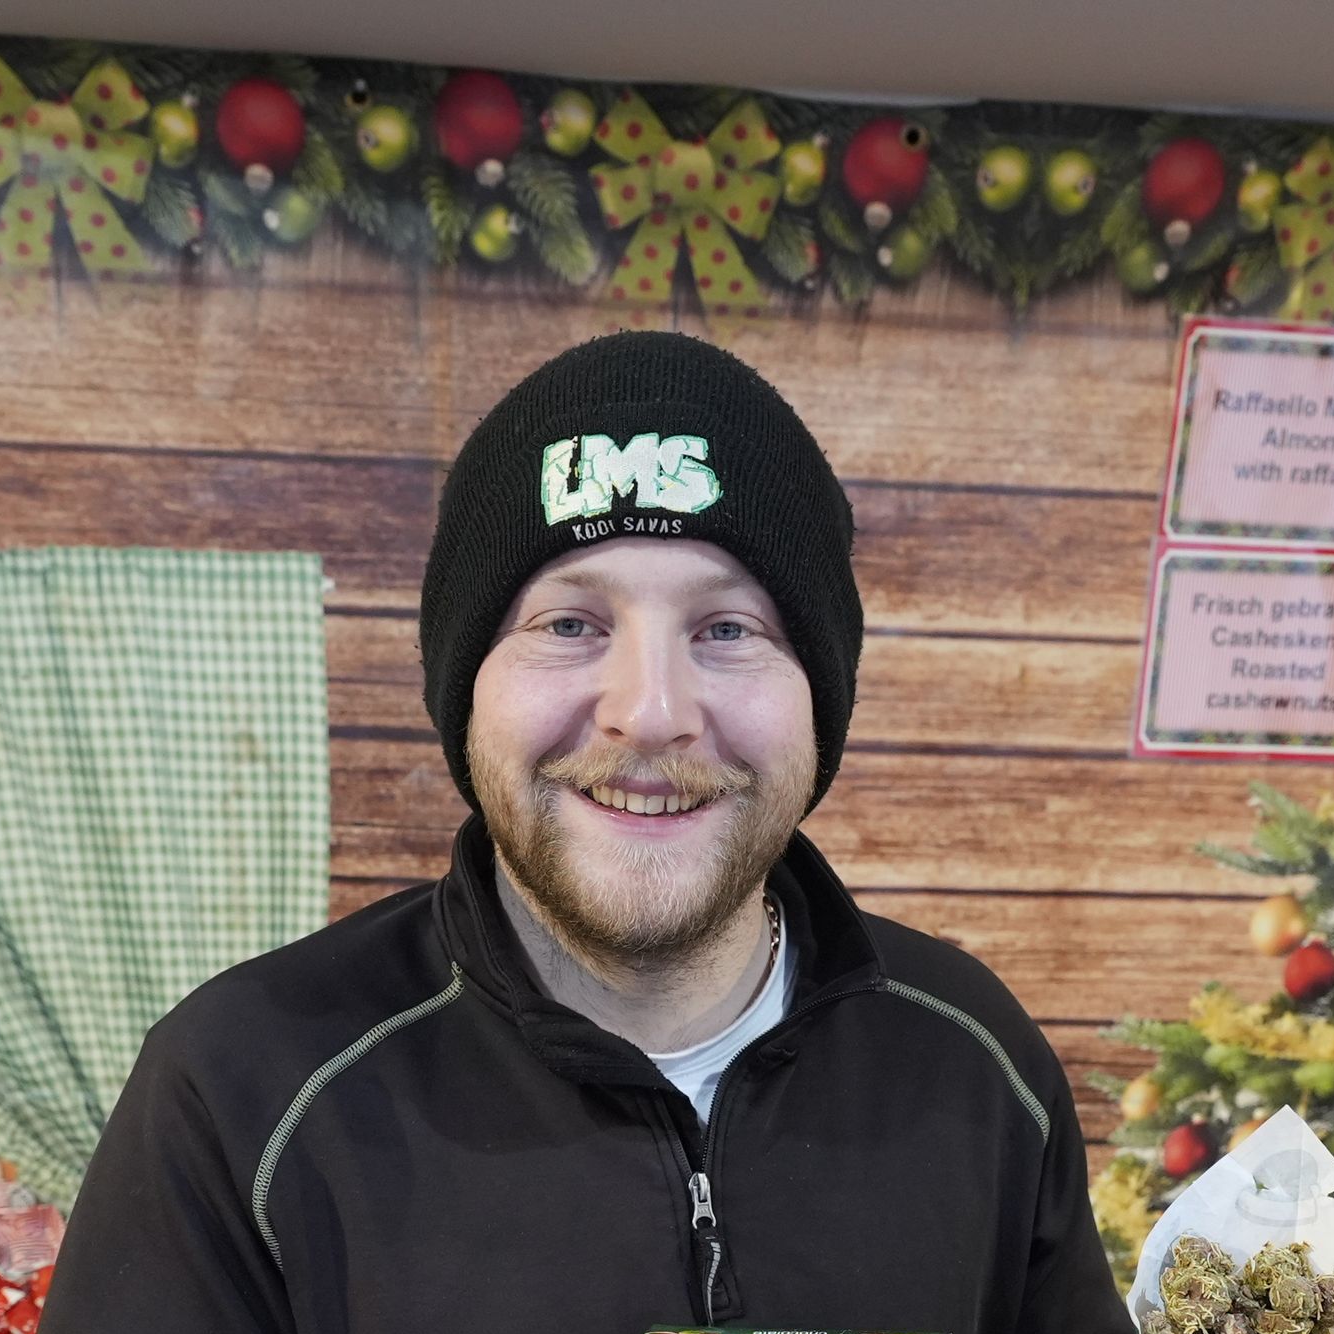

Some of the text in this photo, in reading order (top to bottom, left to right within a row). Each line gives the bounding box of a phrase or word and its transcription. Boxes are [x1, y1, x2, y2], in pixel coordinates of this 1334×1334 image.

[1214, 389, 1317, 417] Raffaello
[1234, 461, 1282, 482] with
[1192, 593, 1264, 616] Frisch
[1230, 657, 1327, 680] Roasted
